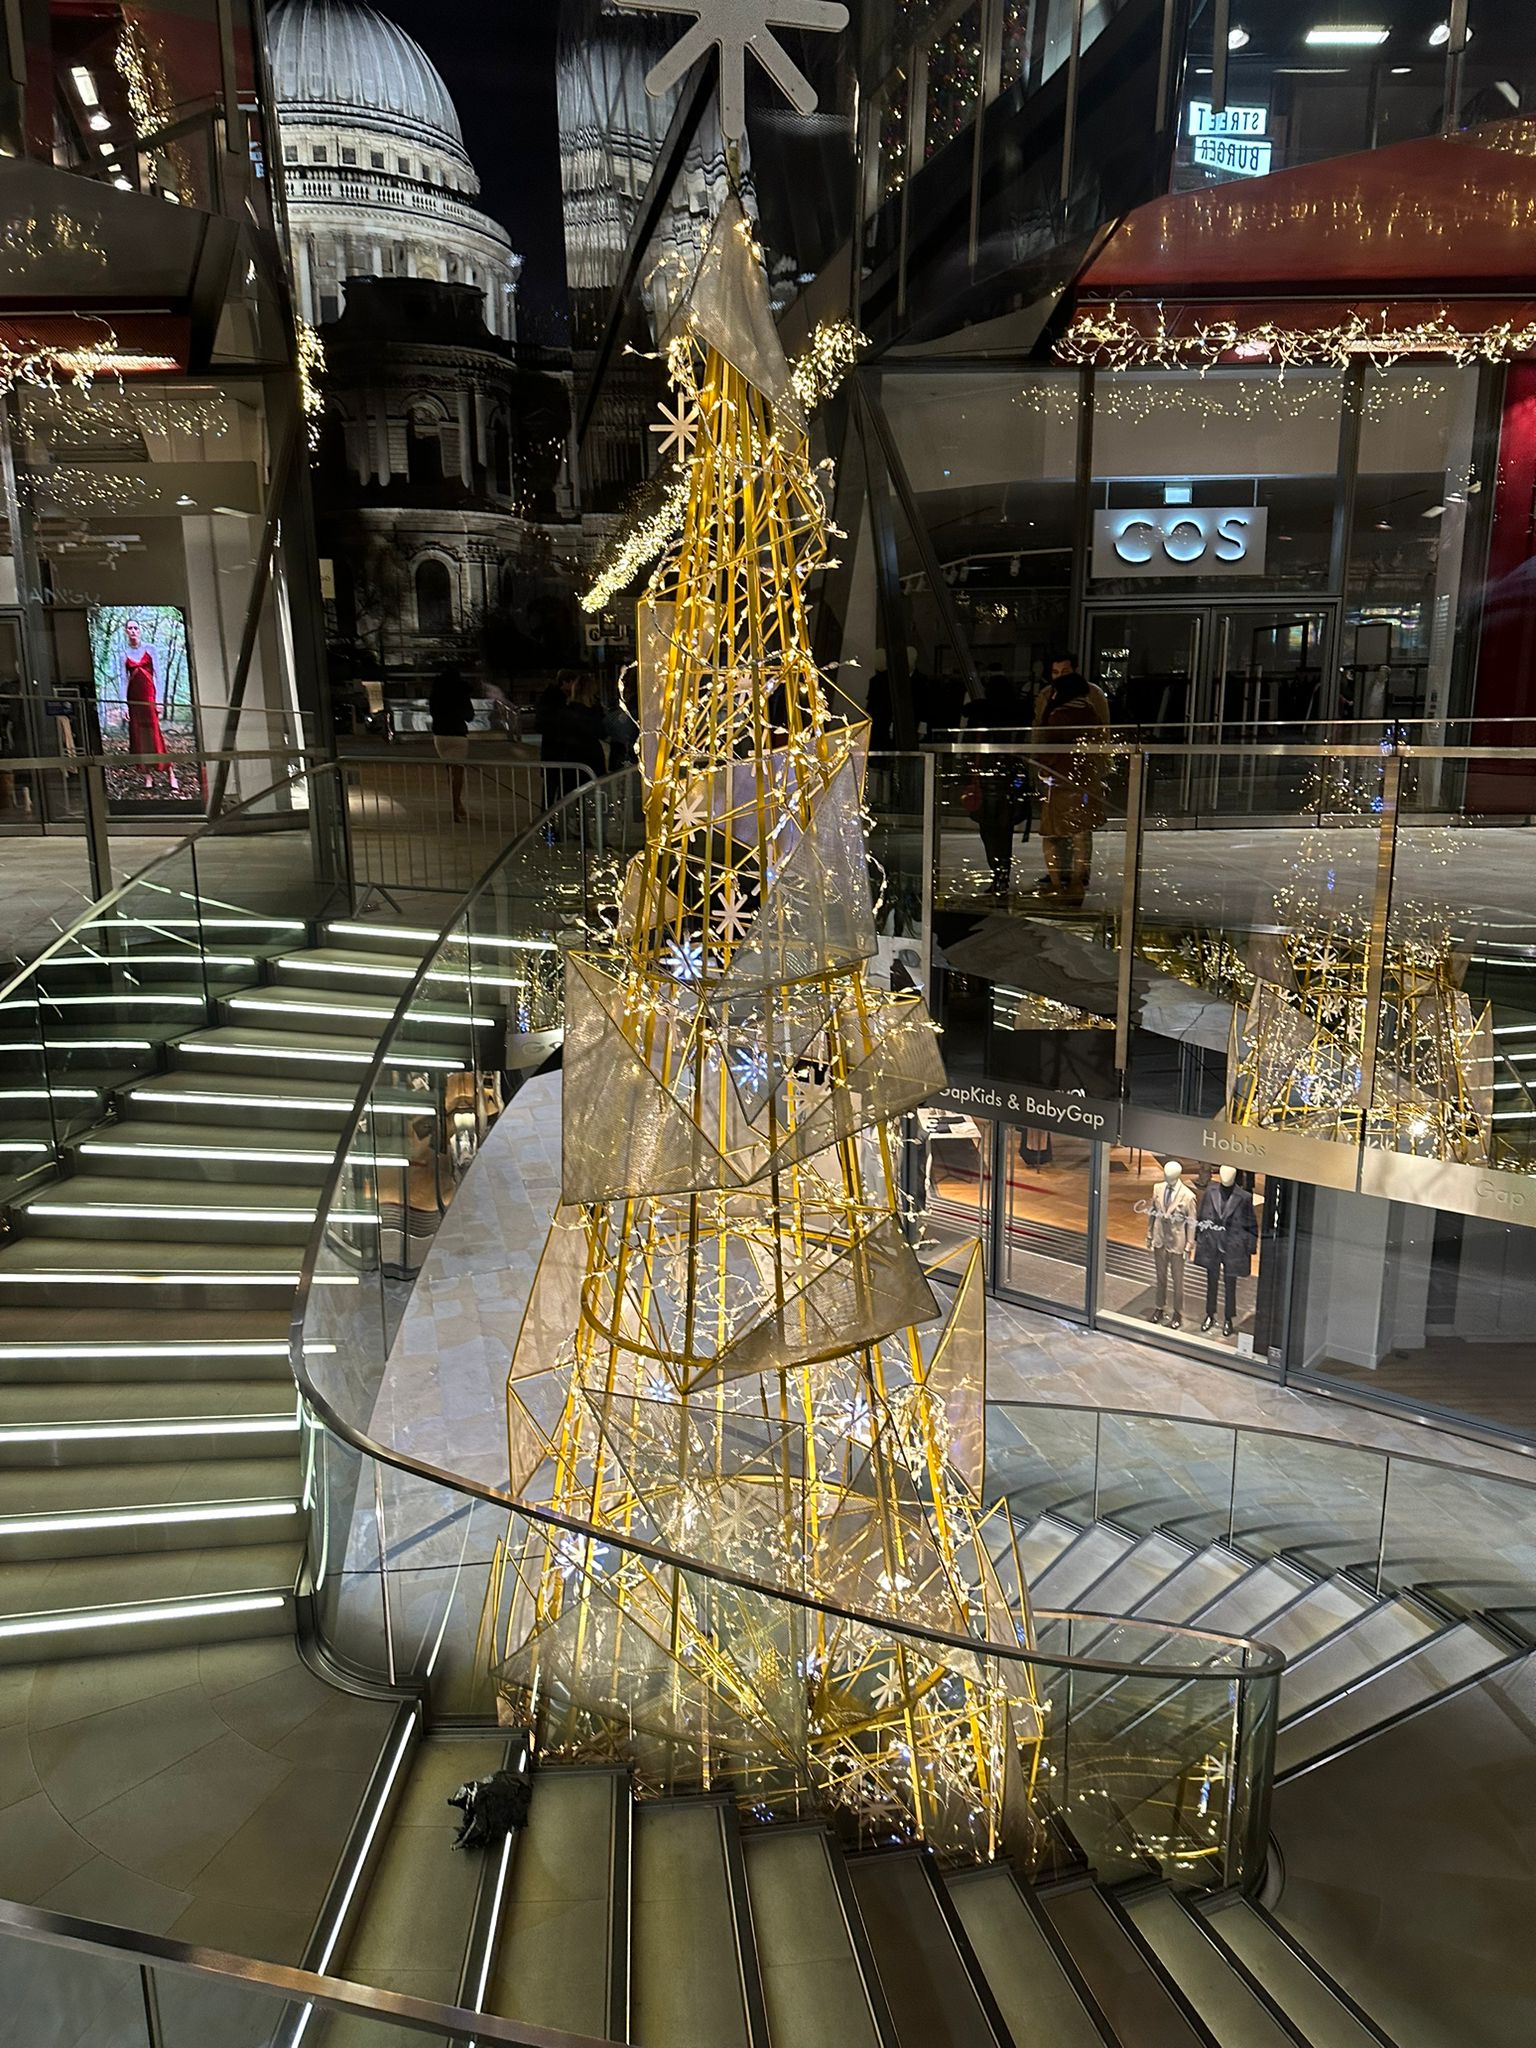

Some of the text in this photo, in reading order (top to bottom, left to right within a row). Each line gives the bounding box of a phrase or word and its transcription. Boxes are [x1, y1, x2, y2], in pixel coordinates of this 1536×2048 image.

[1112, 518, 1249, 563] COS
[1007, 1093, 1021, 1112] &
[1026, 1096, 1105, 1130] BabyGap
[1202, 1128, 1267, 1159] Hobbs
[1475, 1179, 1527, 1211] Gap
